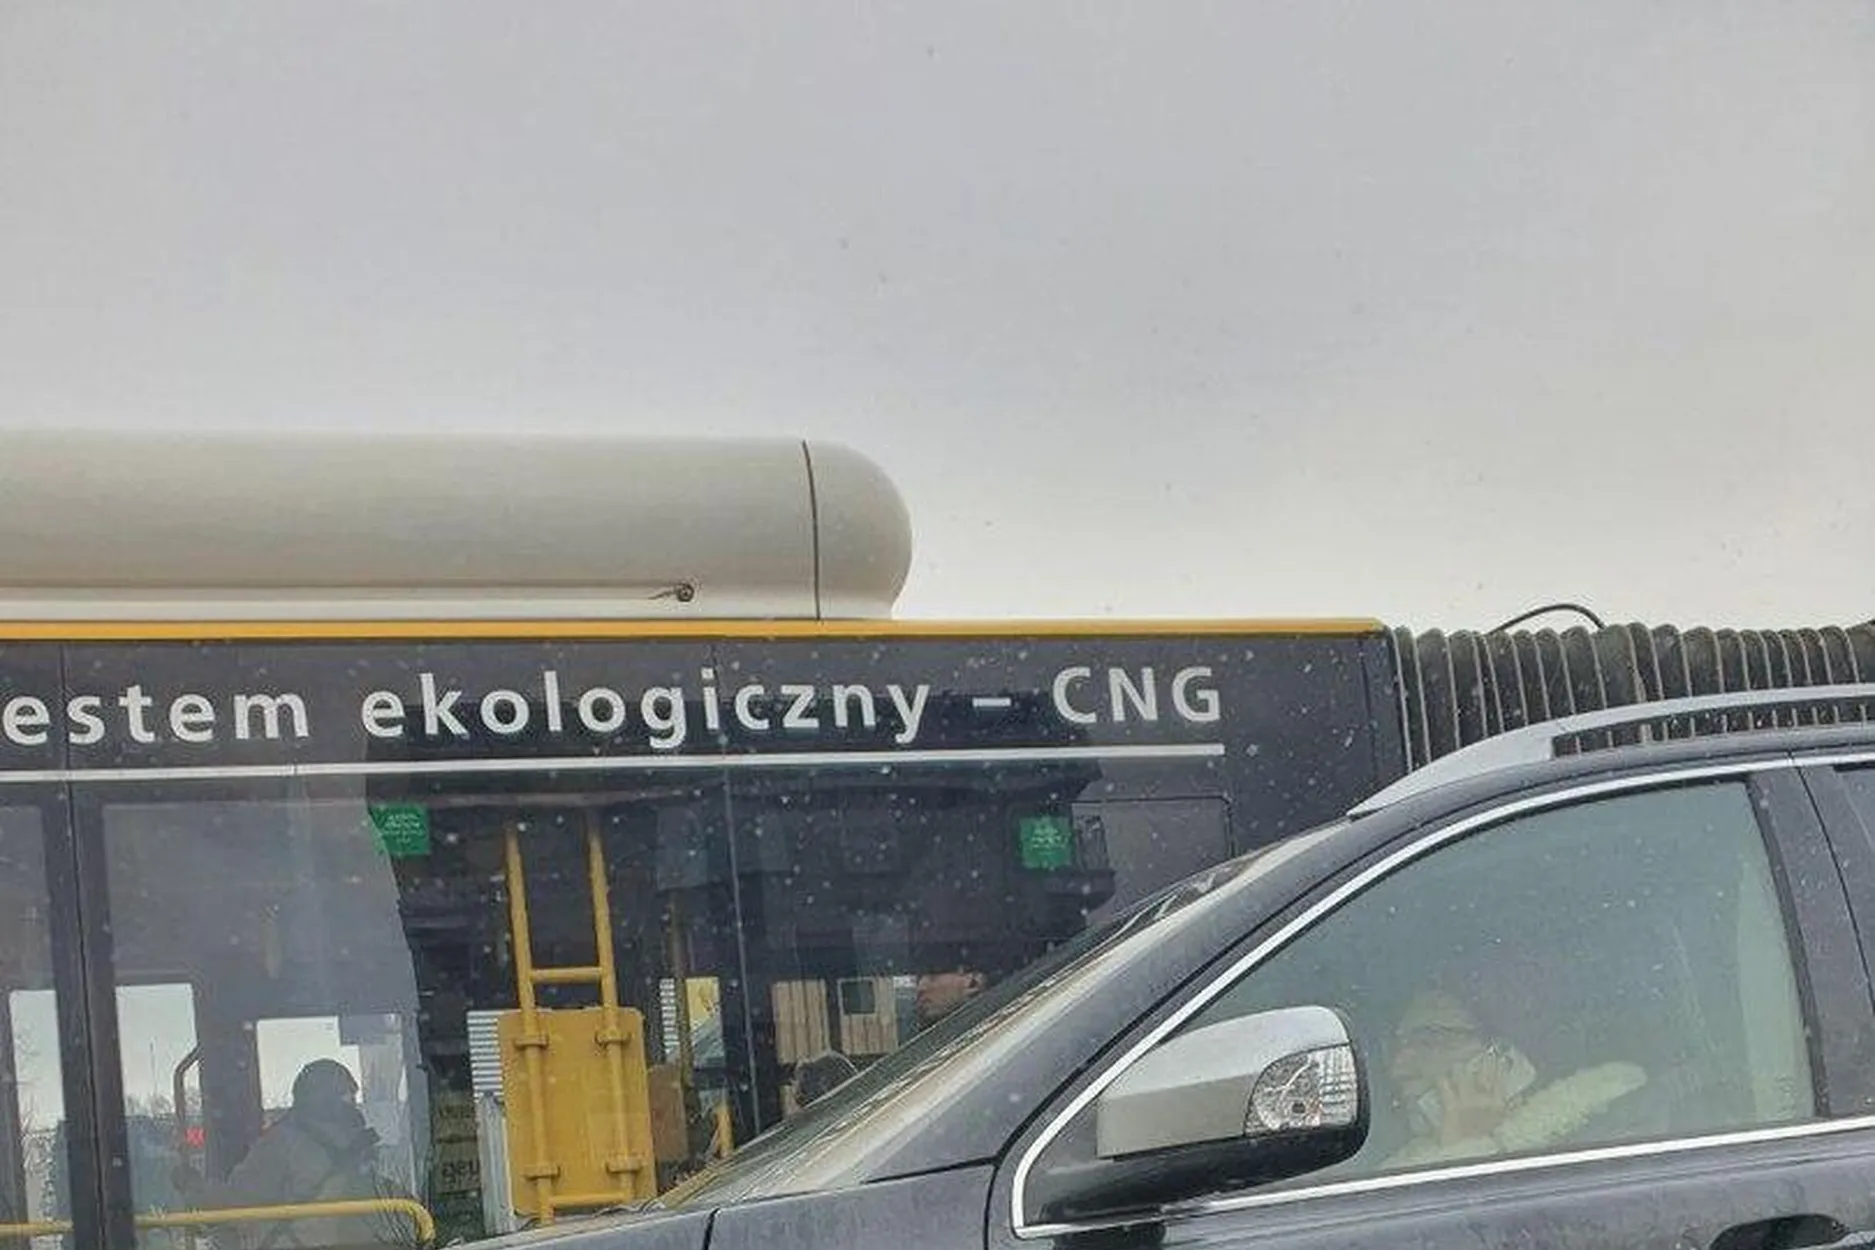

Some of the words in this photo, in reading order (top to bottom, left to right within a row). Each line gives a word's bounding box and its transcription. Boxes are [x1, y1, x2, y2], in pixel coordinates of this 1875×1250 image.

[3, 685, 309, 745] estem
[361, 667, 930, 748] ekologiczny
[1052, 666, 1221, 723] CNG
